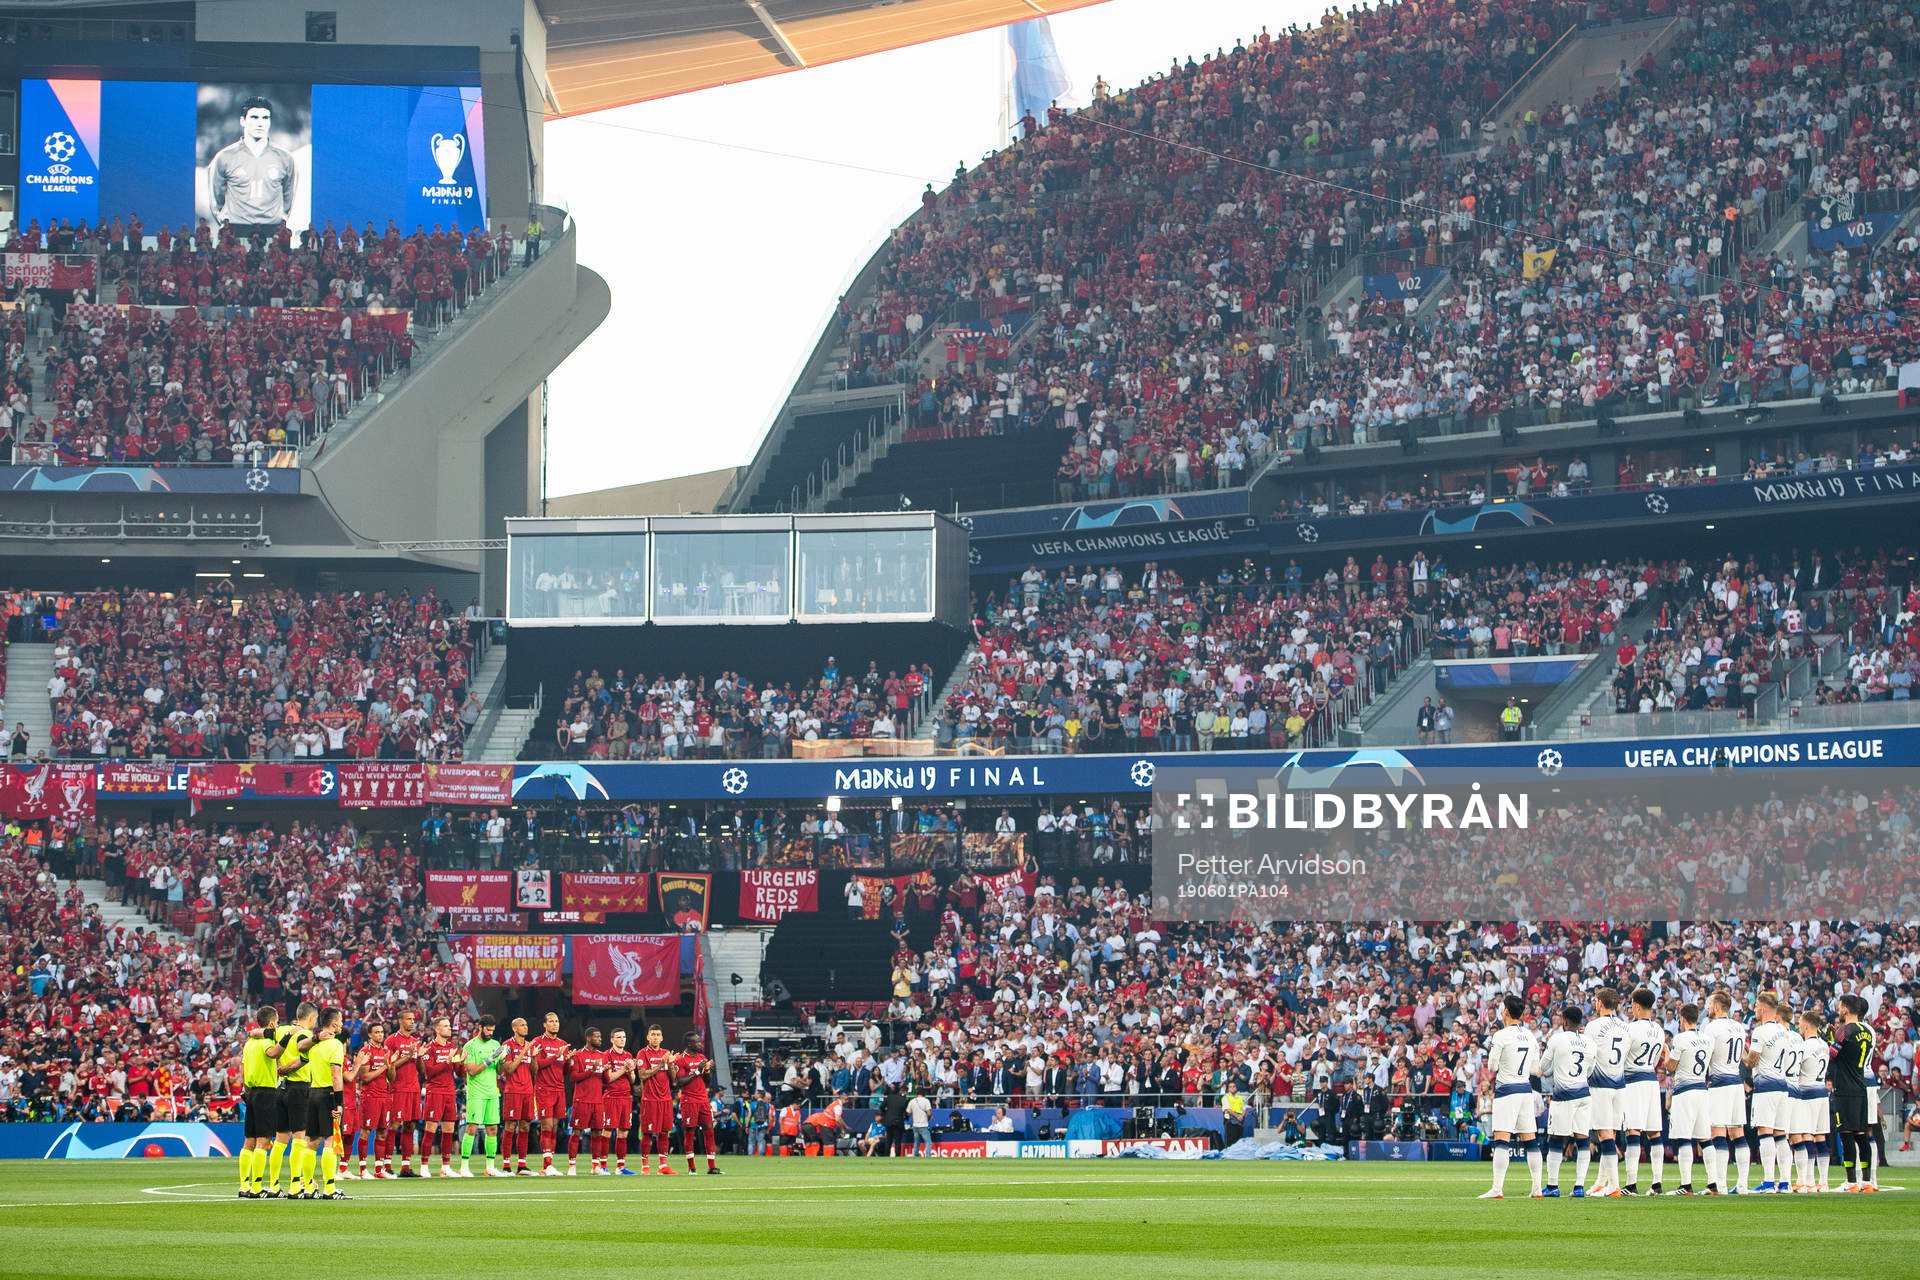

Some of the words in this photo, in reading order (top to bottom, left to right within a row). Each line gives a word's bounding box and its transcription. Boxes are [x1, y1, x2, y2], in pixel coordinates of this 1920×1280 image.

[26, 175, 94, 185] CHAMPIONS
[464, 187, 473, 199] 19
[7, 276, 47, 286] BBBY
[1828, 477, 1846, 496] 19
[1032, 541, 1074, 556] UEFA
[1075, 532, 1166, 552] CHAMPIONS
[1168, 528, 1230, 544] LEAGUE
[1624, 749, 1677, 768] UEFA
[1682, 743, 1800, 766] CHAMPIONS
[1807, 739, 1883, 761] LEAGUE
[112, 773, 129, 782] THE
[131, 773, 160, 782] WORLD
[440, 768, 481, 777] LIVERPOOL
[920, 766, 936, 791] 19
[950, 766, 1045, 788] FINAL
[430, 791, 467, 799] MENTALITY
[574, 875, 622, 885] LIVERPOOL
[624, 876, 636, 885] FC
[756, 888, 798, 906] REDS
[432, 906, 445, 914] AND
[449, 906, 479, 914] DRIFTING
[588, 935, 606, 945] LOS
[476, 945, 512, 958] NEVER
[514, 945, 540, 958] GIVE
[543, 945, 559, 958] UP
[476, 958, 519, 969] EUROPEAN
[521, 958, 558, 969] ROYALTY
[1608, 1037, 1623, 1065] 5
[1633, 1042, 1662, 1067] 20
[1726, 1037, 1744, 1065] 10
[1857, 1040, 1867, 1069] 1
[1517, 1047, 1529, 1076] 7
[1568, 1050, 1585, 1078] 3
[1693, 1049, 1707, 1076] 8
[1774, 1048, 1786, 1074] 4
[1022, 1145, 1066, 1158] GAZPROM
